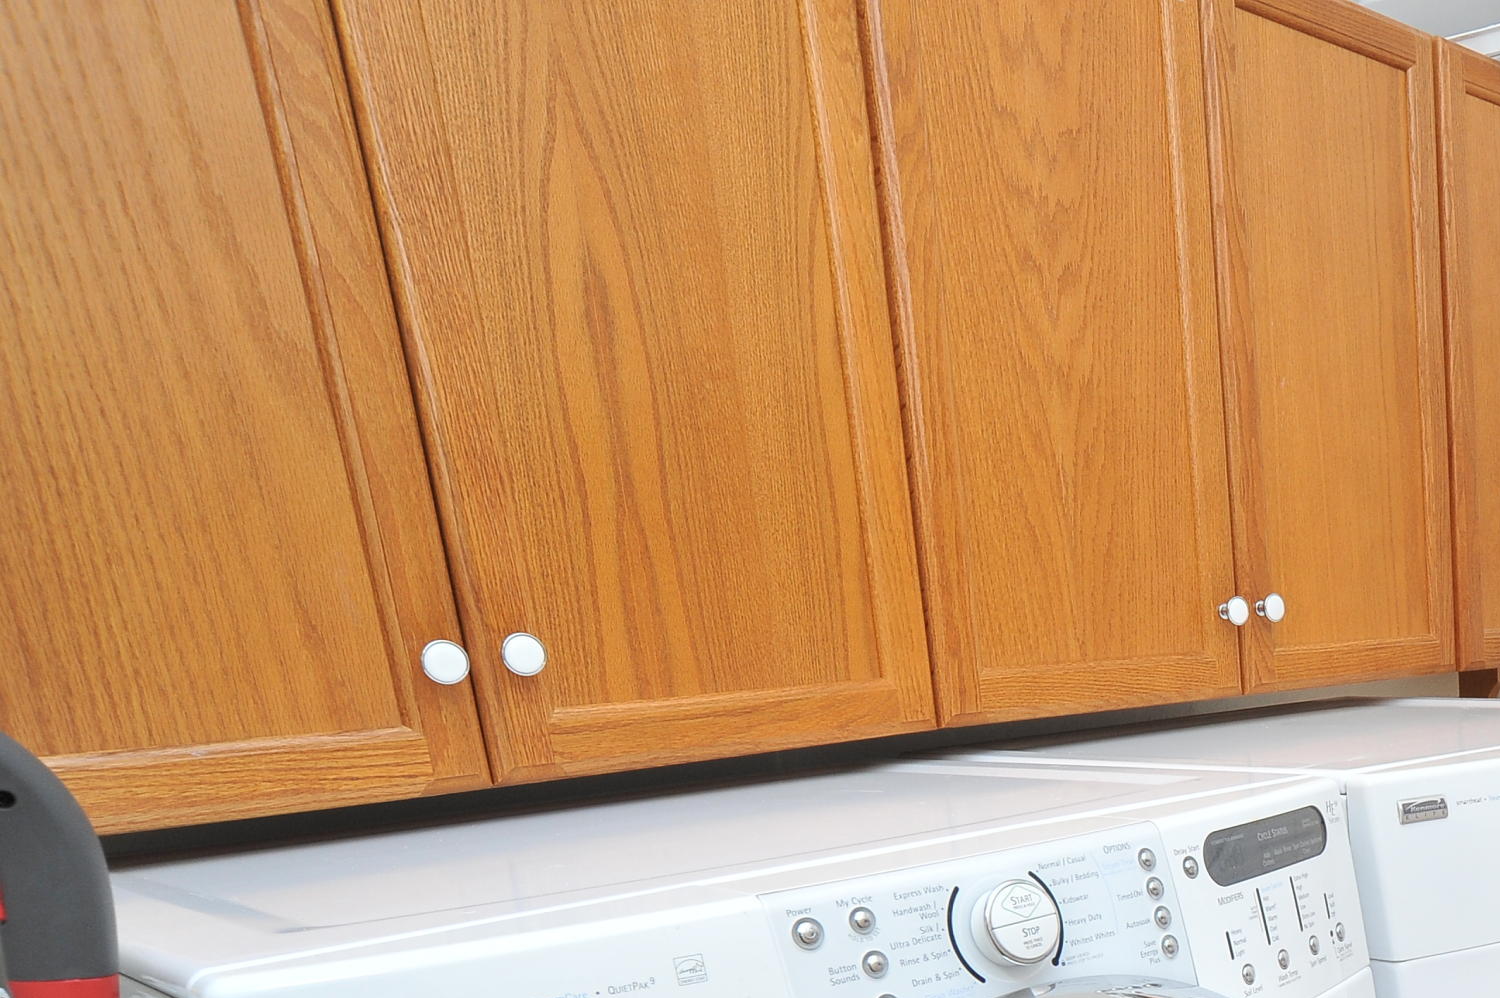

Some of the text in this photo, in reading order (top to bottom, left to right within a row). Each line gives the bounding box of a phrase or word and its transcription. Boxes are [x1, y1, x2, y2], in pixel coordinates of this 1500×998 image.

[893, 885, 944, 901] Express Wash
[836, 896, 873, 909] My Cycle
[1010, 894, 1033, 905] START
[786, 907, 812, 918] Power
[893, 903, 931, 917] Handwash
[919, 910, 940, 920] Wool
[1068, 917, 1087, 927] Heavy
[920, 924, 934, 934] Silk
[1022, 926, 1040, 938] STOP
[889, 933, 943, 950] Ultra Delicate
[899, 956, 920, 967] Rinse
[931, 950, 949, 961] Spin
[828, 963, 857, 976] Button
[830, 974, 860, 986] Sounds
[911, 976, 933, 987] Drain
[943, 970, 960, 980] Spin
